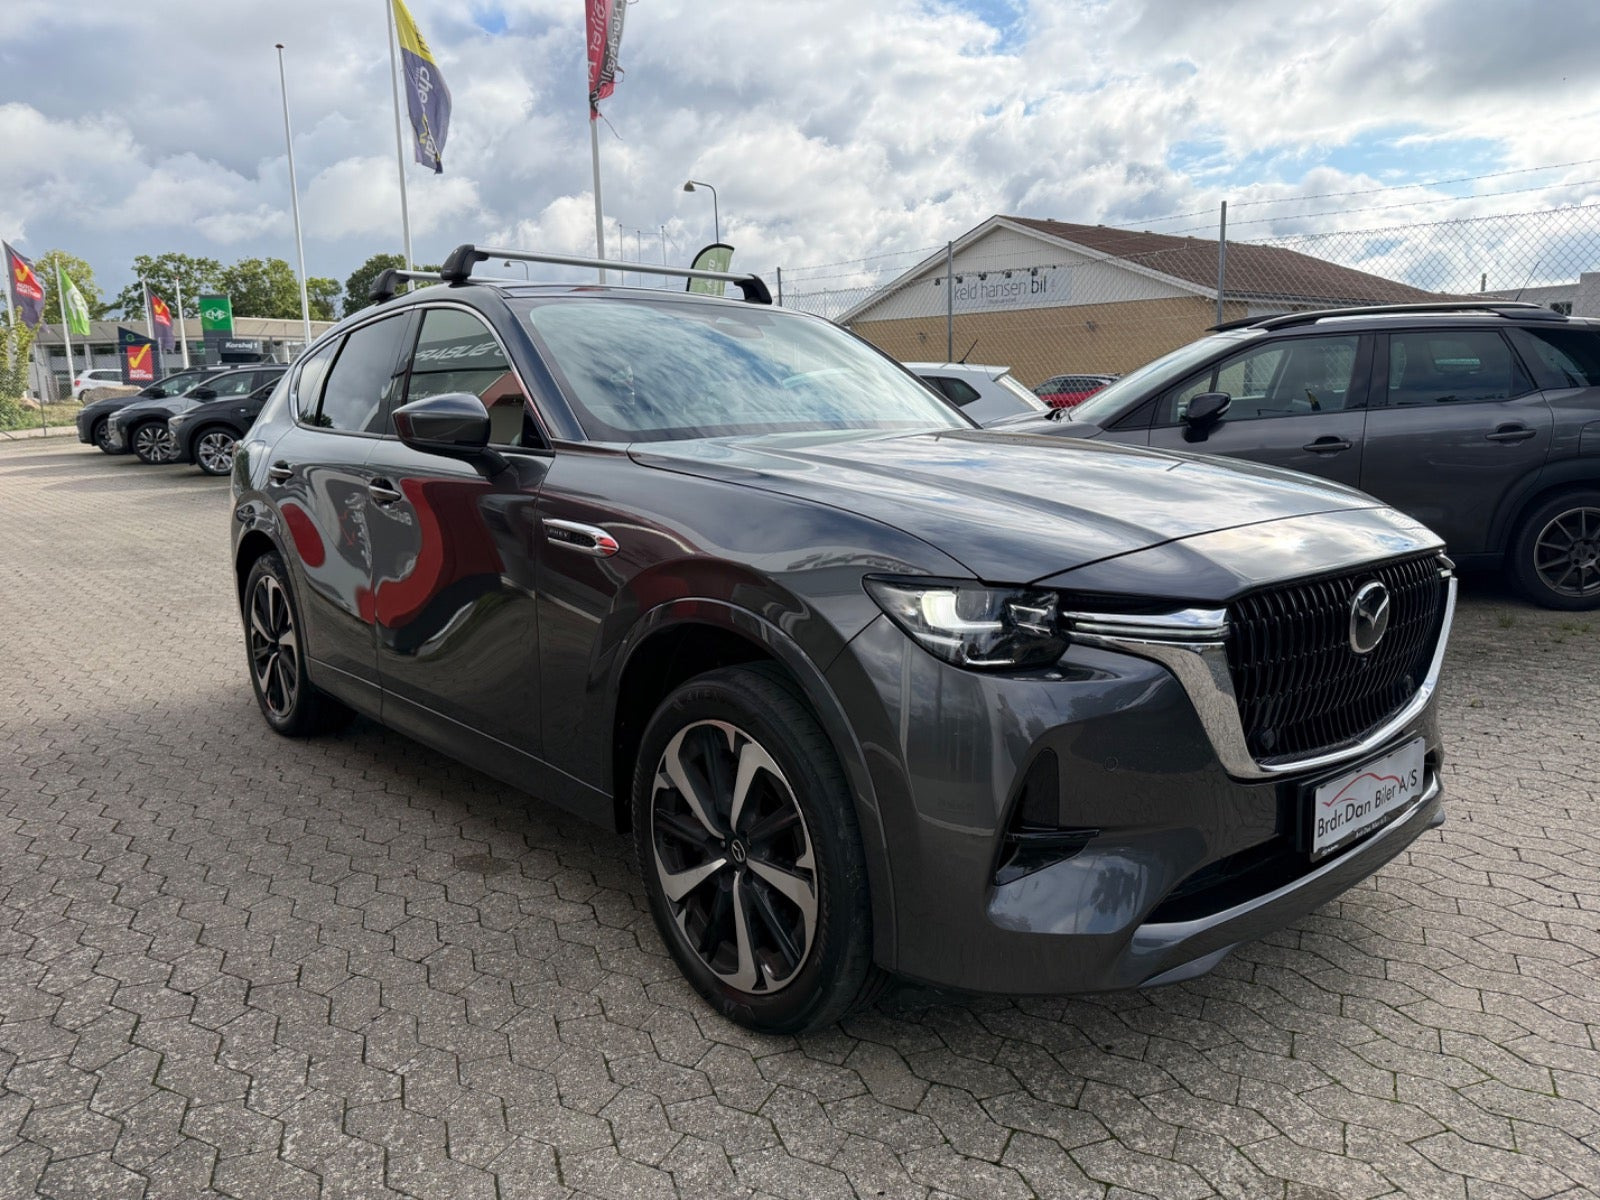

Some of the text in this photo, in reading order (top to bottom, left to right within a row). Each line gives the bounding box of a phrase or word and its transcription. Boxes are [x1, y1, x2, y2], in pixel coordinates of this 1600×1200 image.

[954, 283, 978, 302] keld
[980, 281, 1028, 299] hansen
[1031, 275, 1047, 294] bil
[1375, 785, 1397, 808] Biler
[1399, 769, 1418, 794] A/S
